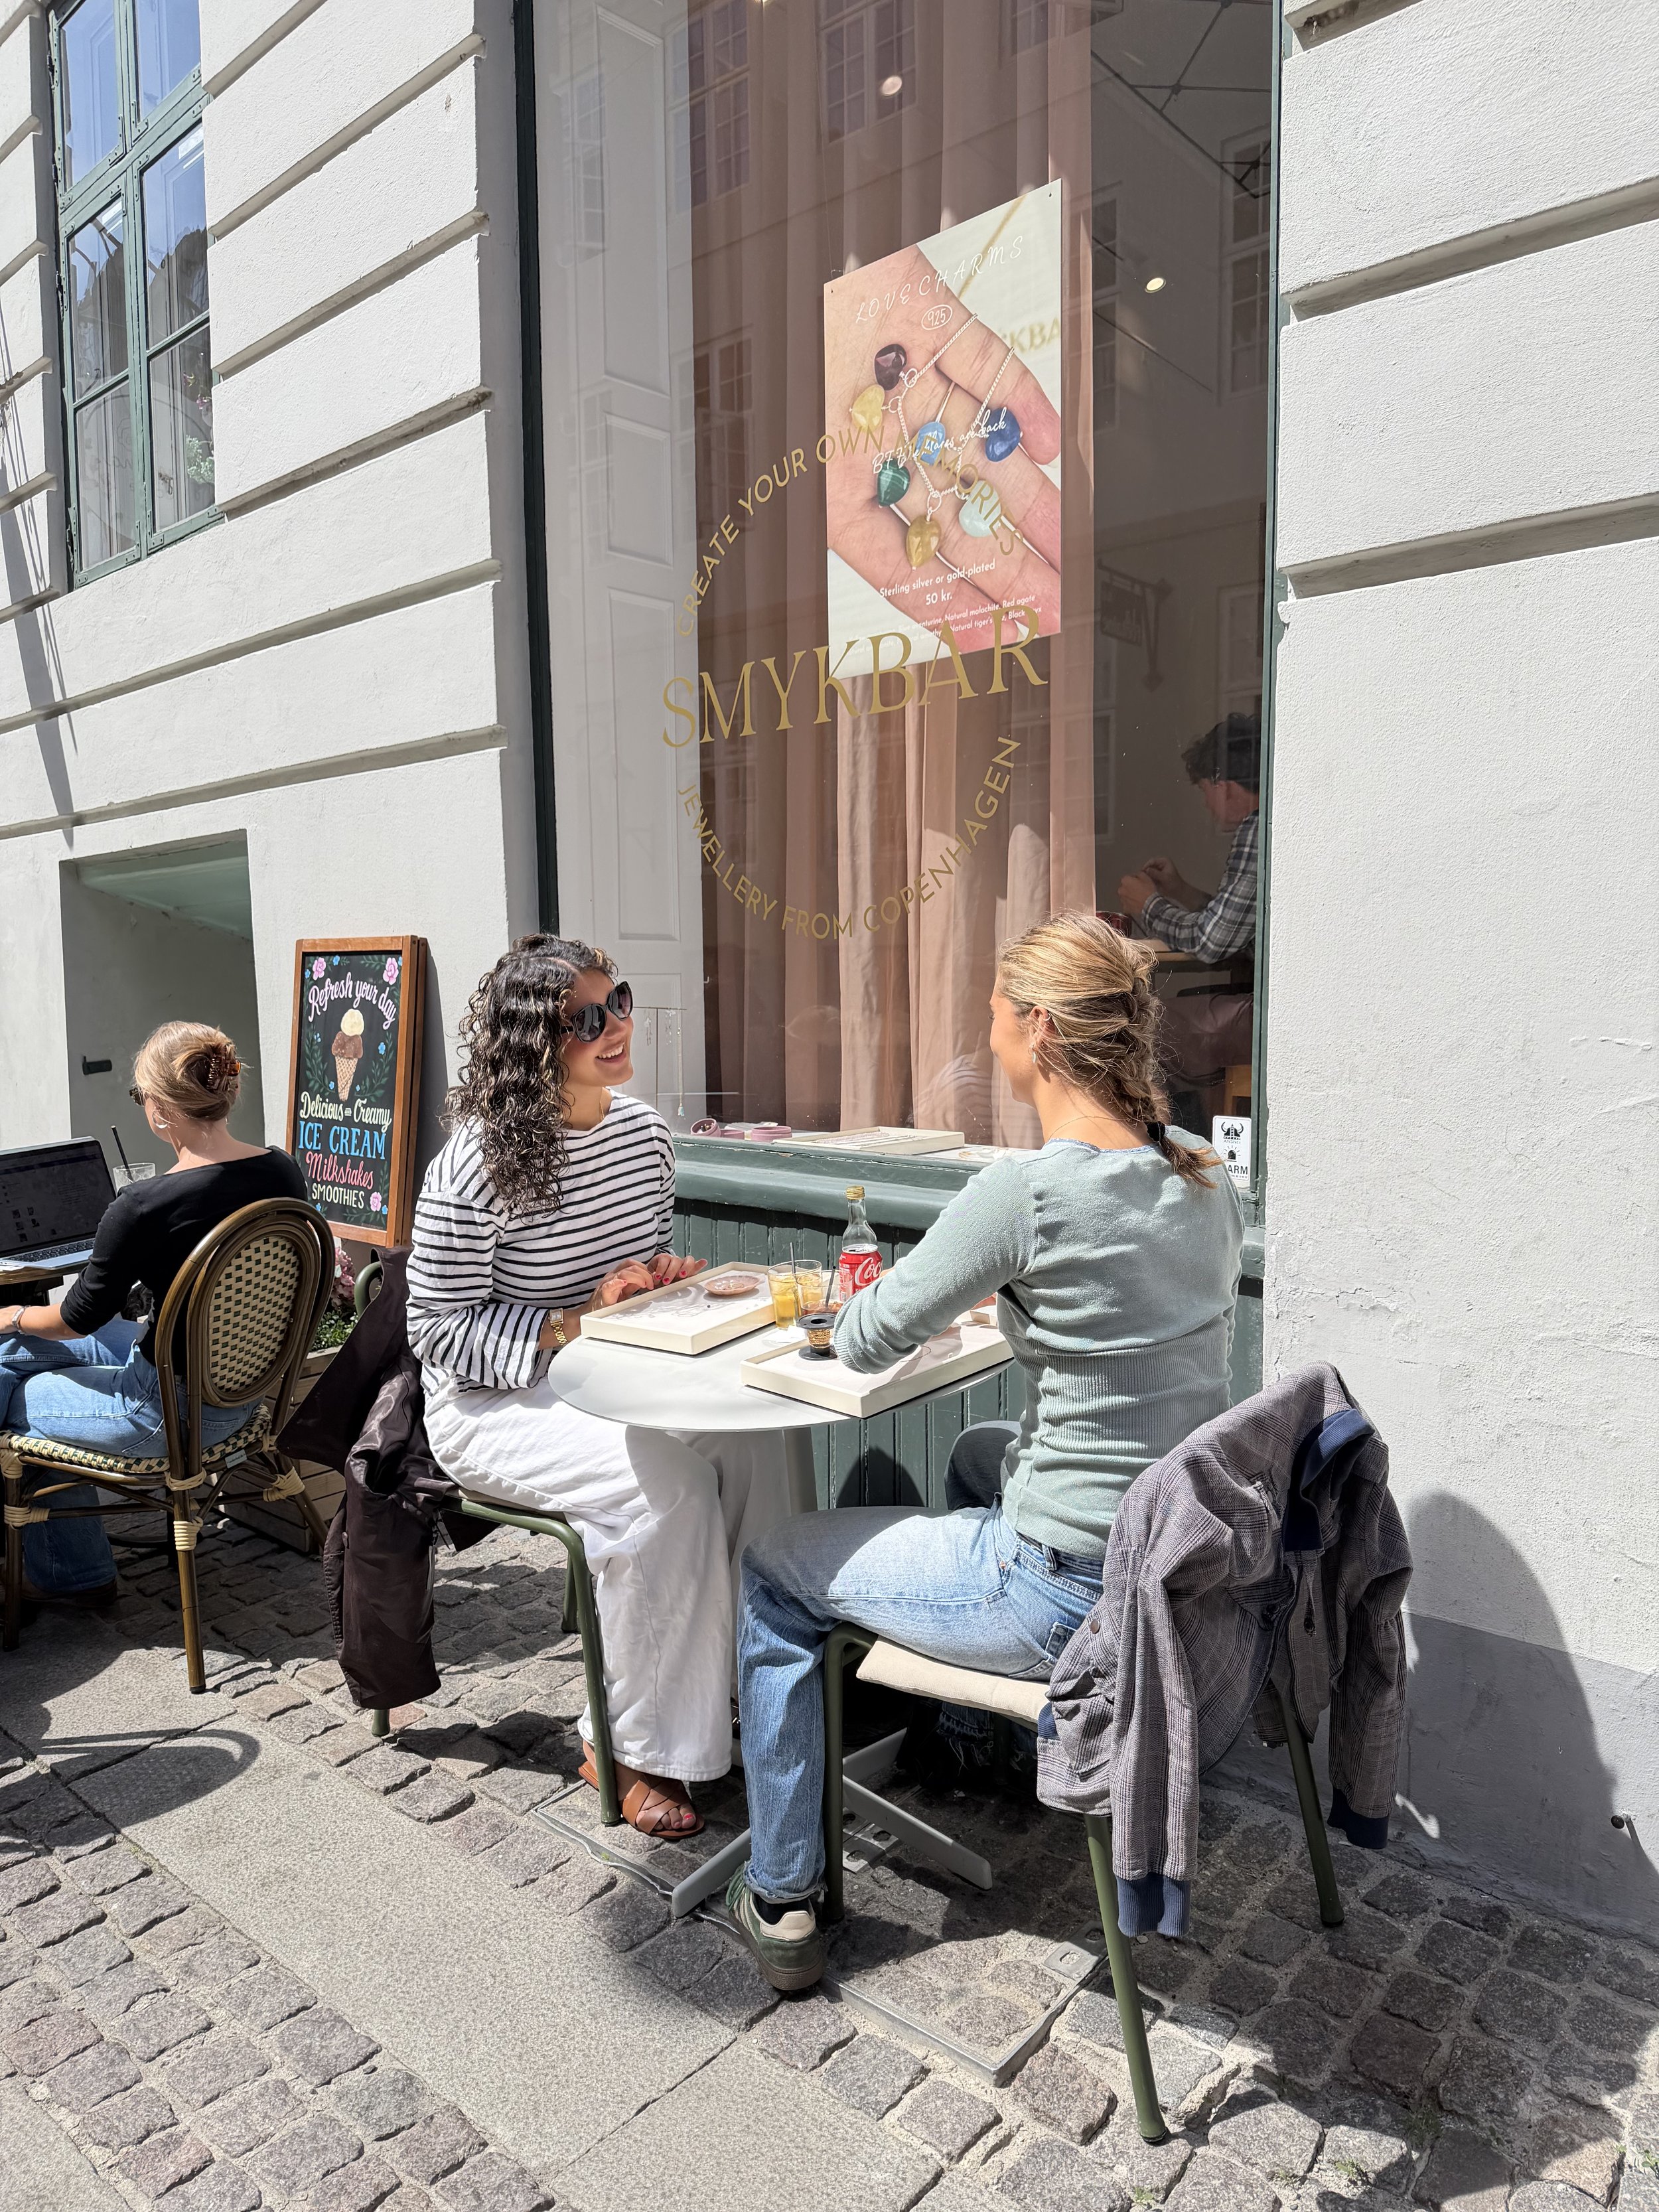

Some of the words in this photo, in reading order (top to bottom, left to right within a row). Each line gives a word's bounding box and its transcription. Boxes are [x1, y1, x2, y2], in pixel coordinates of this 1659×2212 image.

[927, 308, 946, 327] 925
[1010, 318, 1060, 354] KBA
[980, 406, 1007, 434] back
[677, 514, 739, 636] CREATE
[738, 448, 808, 516] YOUR
[816, 425, 885, 463] OWN
[895, 431, 1023, 555] MEMORIES
[880, 581, 910, 598] Sterling
[912, 576, 933, 591] silver
[935, 575, 944, 585] or
[947, 558, 995, 583] gold-plated
[926, 593, 938, 605] 50
[941, 589, 952, 602] kr.
[945, 609, 968, 621] Natural
[1003, 598, 1015, 608] Red
[1017, 595, 1035, 606] agate
[1008, 610, 1025, 620] Black
[662, 605, 1048, 748] SMYKBAR
[678, 784, 778, 921] JEWELLERY
[782, 905, 852, 940] FROM
[864, 737, 1021, 932] COPENHAGEN
[308, 972, 352, 1023] Refresh
[352, 978, 379, 1009] your
[378, 988, 396, 1030] day
[299, 1091, 344, 1120] Delicious
[353, 1098, 392, 1134] Creamy
[298, 1121, 322, 1151] ICE
[329, 1125, 386, 1160] CREAM
[305, 1151, 374, 1191] Milkshakes
[1228, 1164, 1248, 1175] ARM
[312, 1190, 364, 1209] SMOOTHIES
[854, 1257, 882, 1286] Coc
